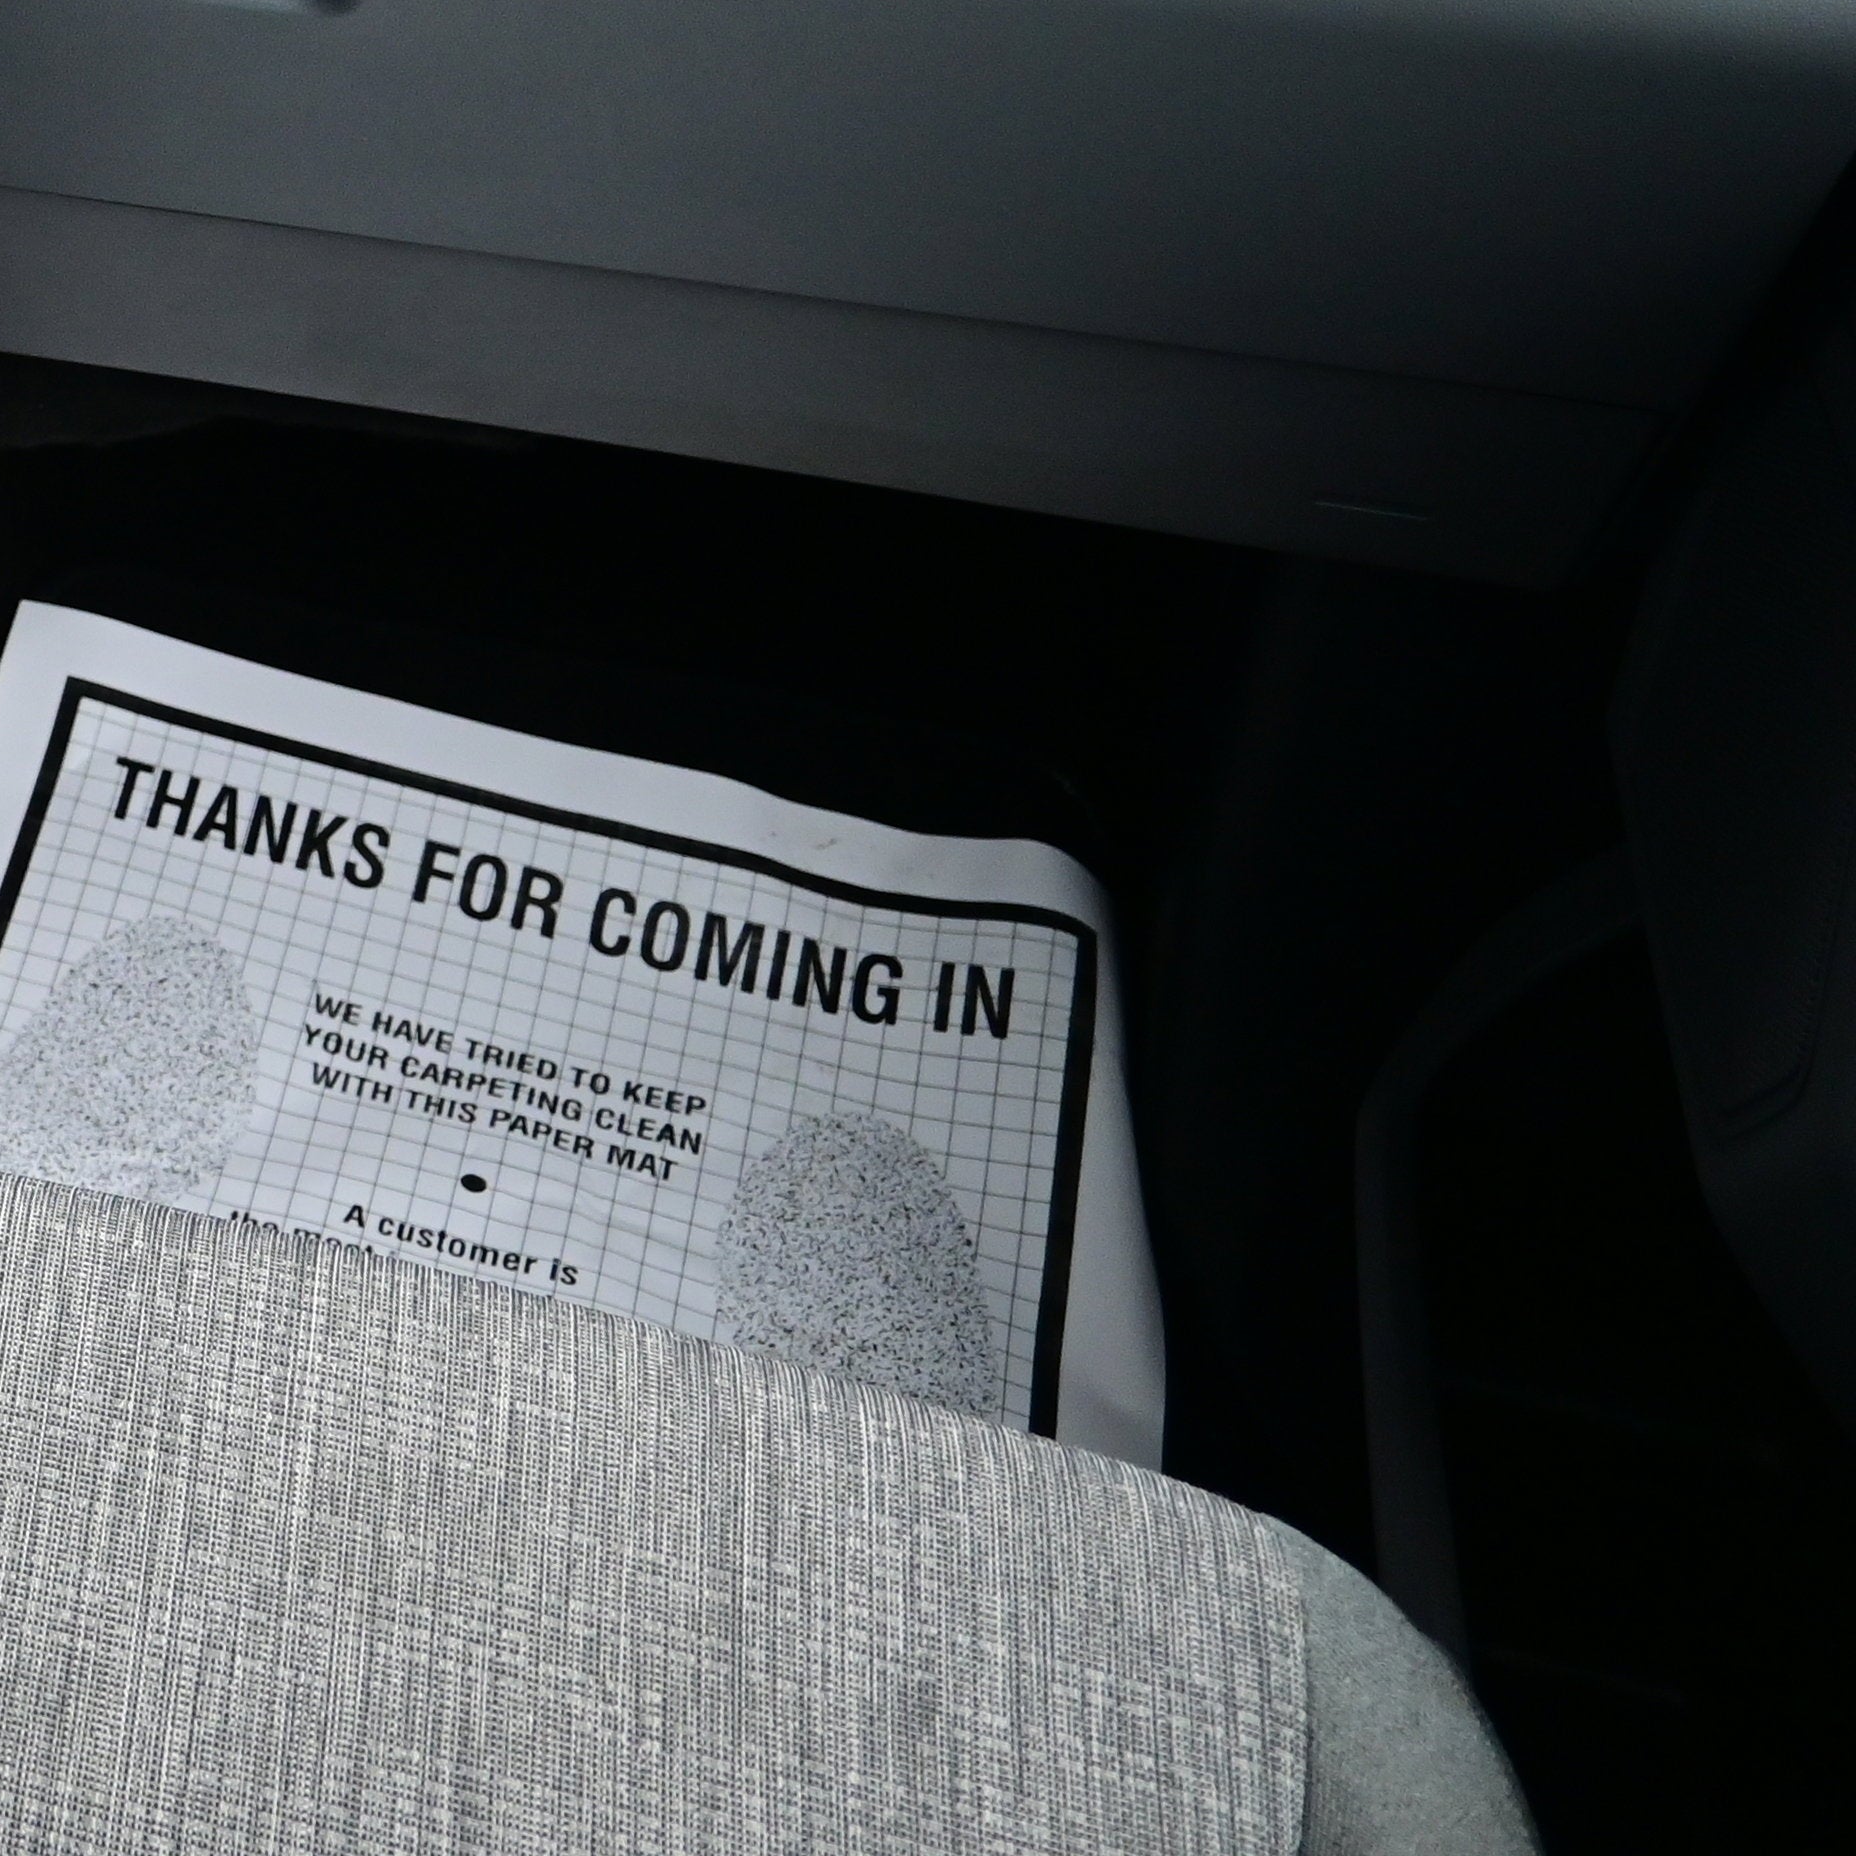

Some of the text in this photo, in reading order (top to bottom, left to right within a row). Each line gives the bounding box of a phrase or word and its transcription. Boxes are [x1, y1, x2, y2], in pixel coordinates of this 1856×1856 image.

[114, 756, 1016, 1040] THANKS FOR COMING IN
[304, 1024, 704, 1155] YOUR CARPETING CLEAN
[314, 993, 707, 1117] WE HAVE TRIED TO KEEP
[312, 1063, 679, 1181] WITH THIS PAPER MAT
[344, 1204, 366, 1228] A
[378, 1215, 538, 1276] customer
[549, 1258, 579, 1286] is
